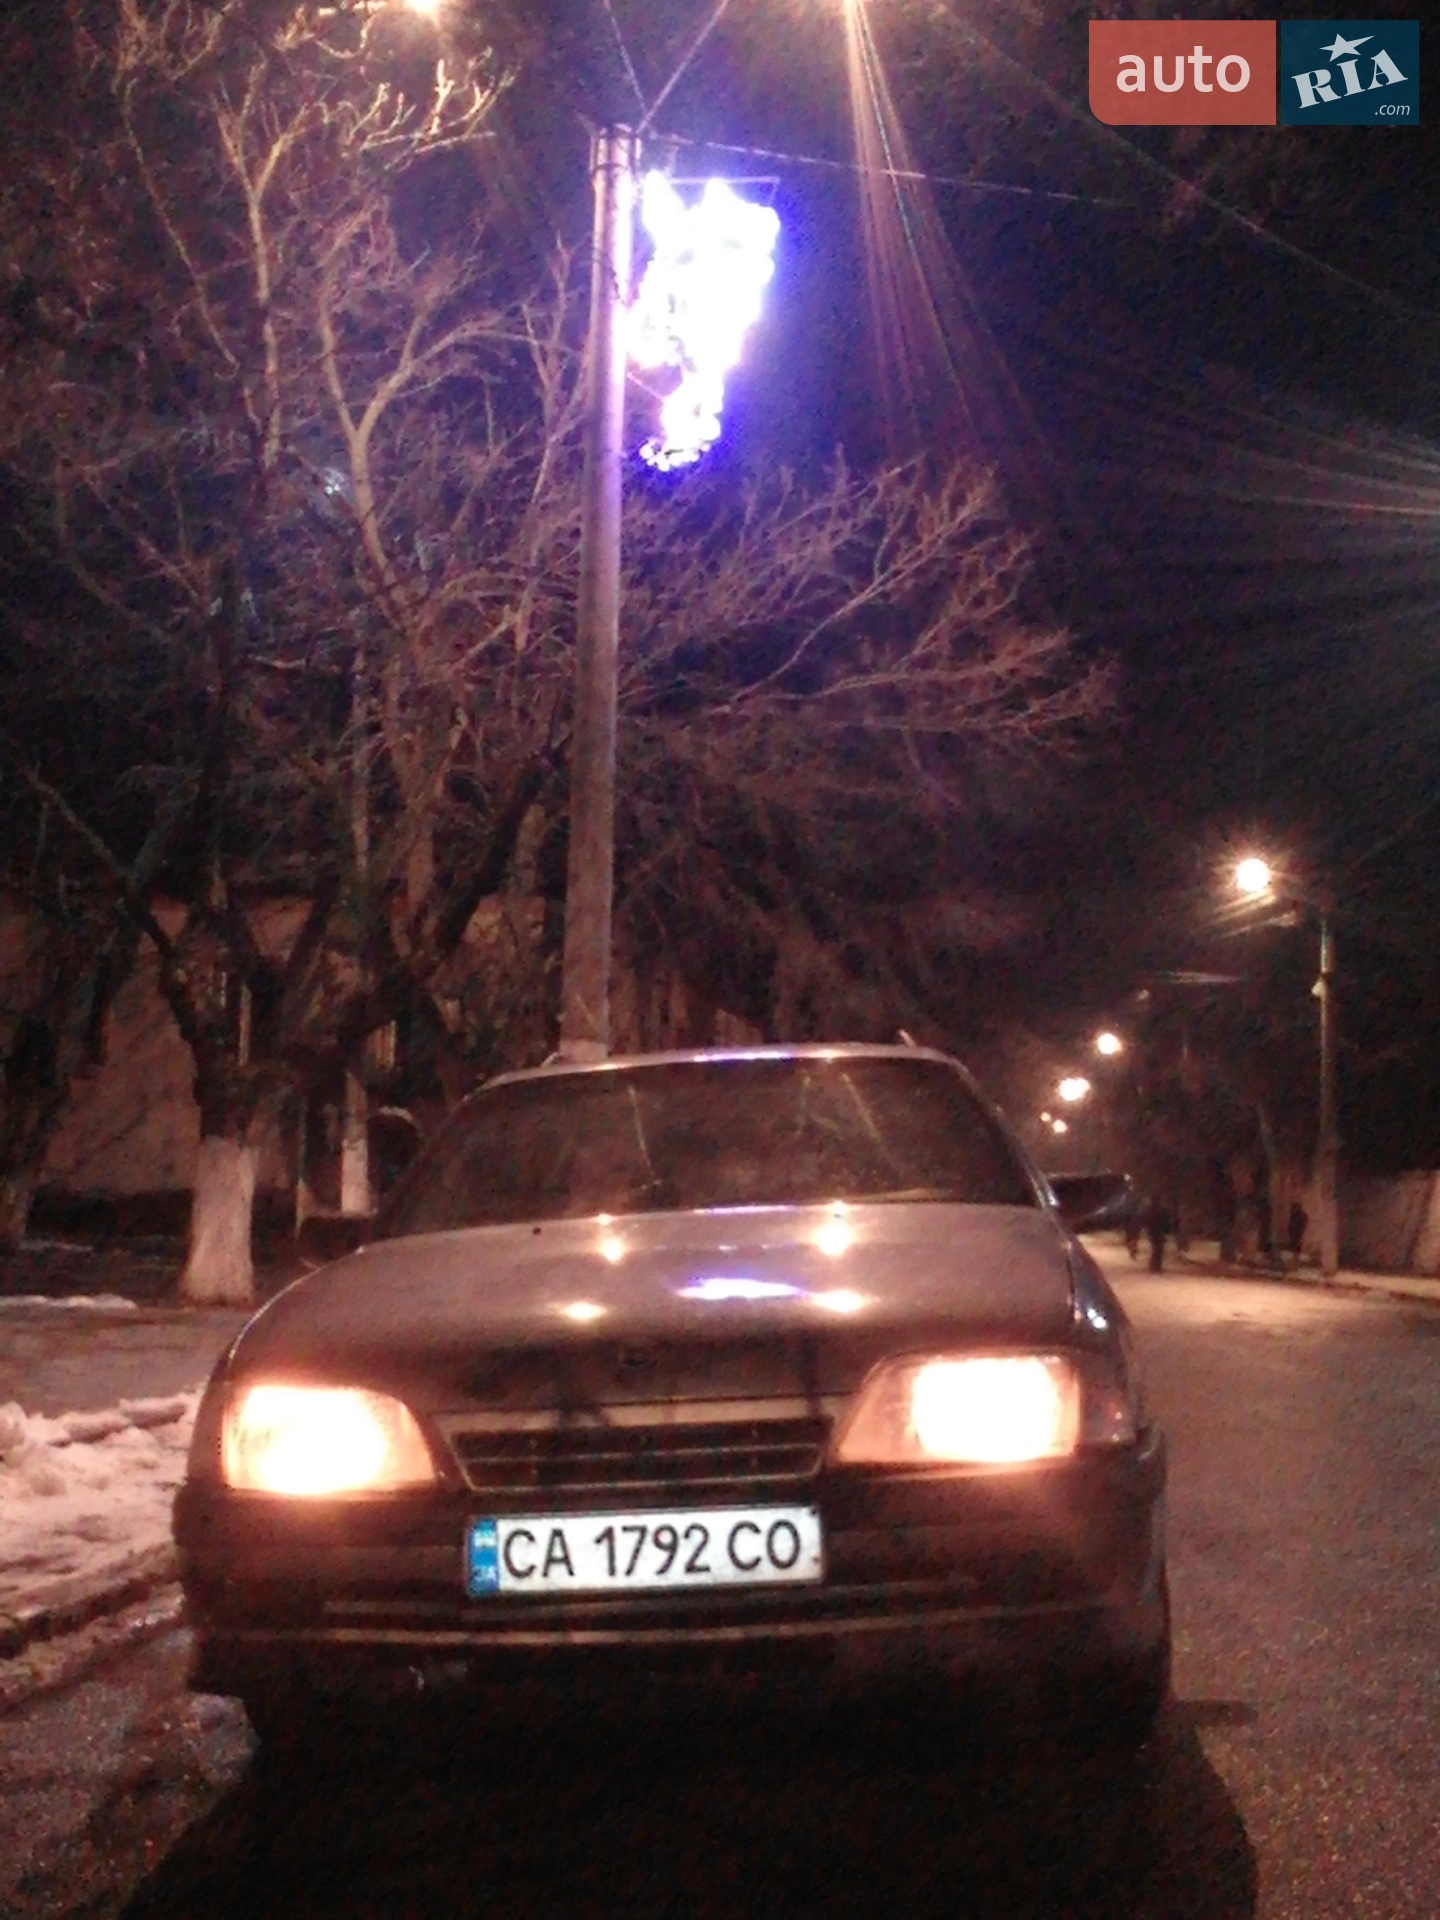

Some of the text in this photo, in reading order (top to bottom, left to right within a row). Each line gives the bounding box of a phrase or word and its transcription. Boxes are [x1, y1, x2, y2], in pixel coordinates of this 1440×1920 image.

[503, 1519, 801, 1578] CA 1792 CO
